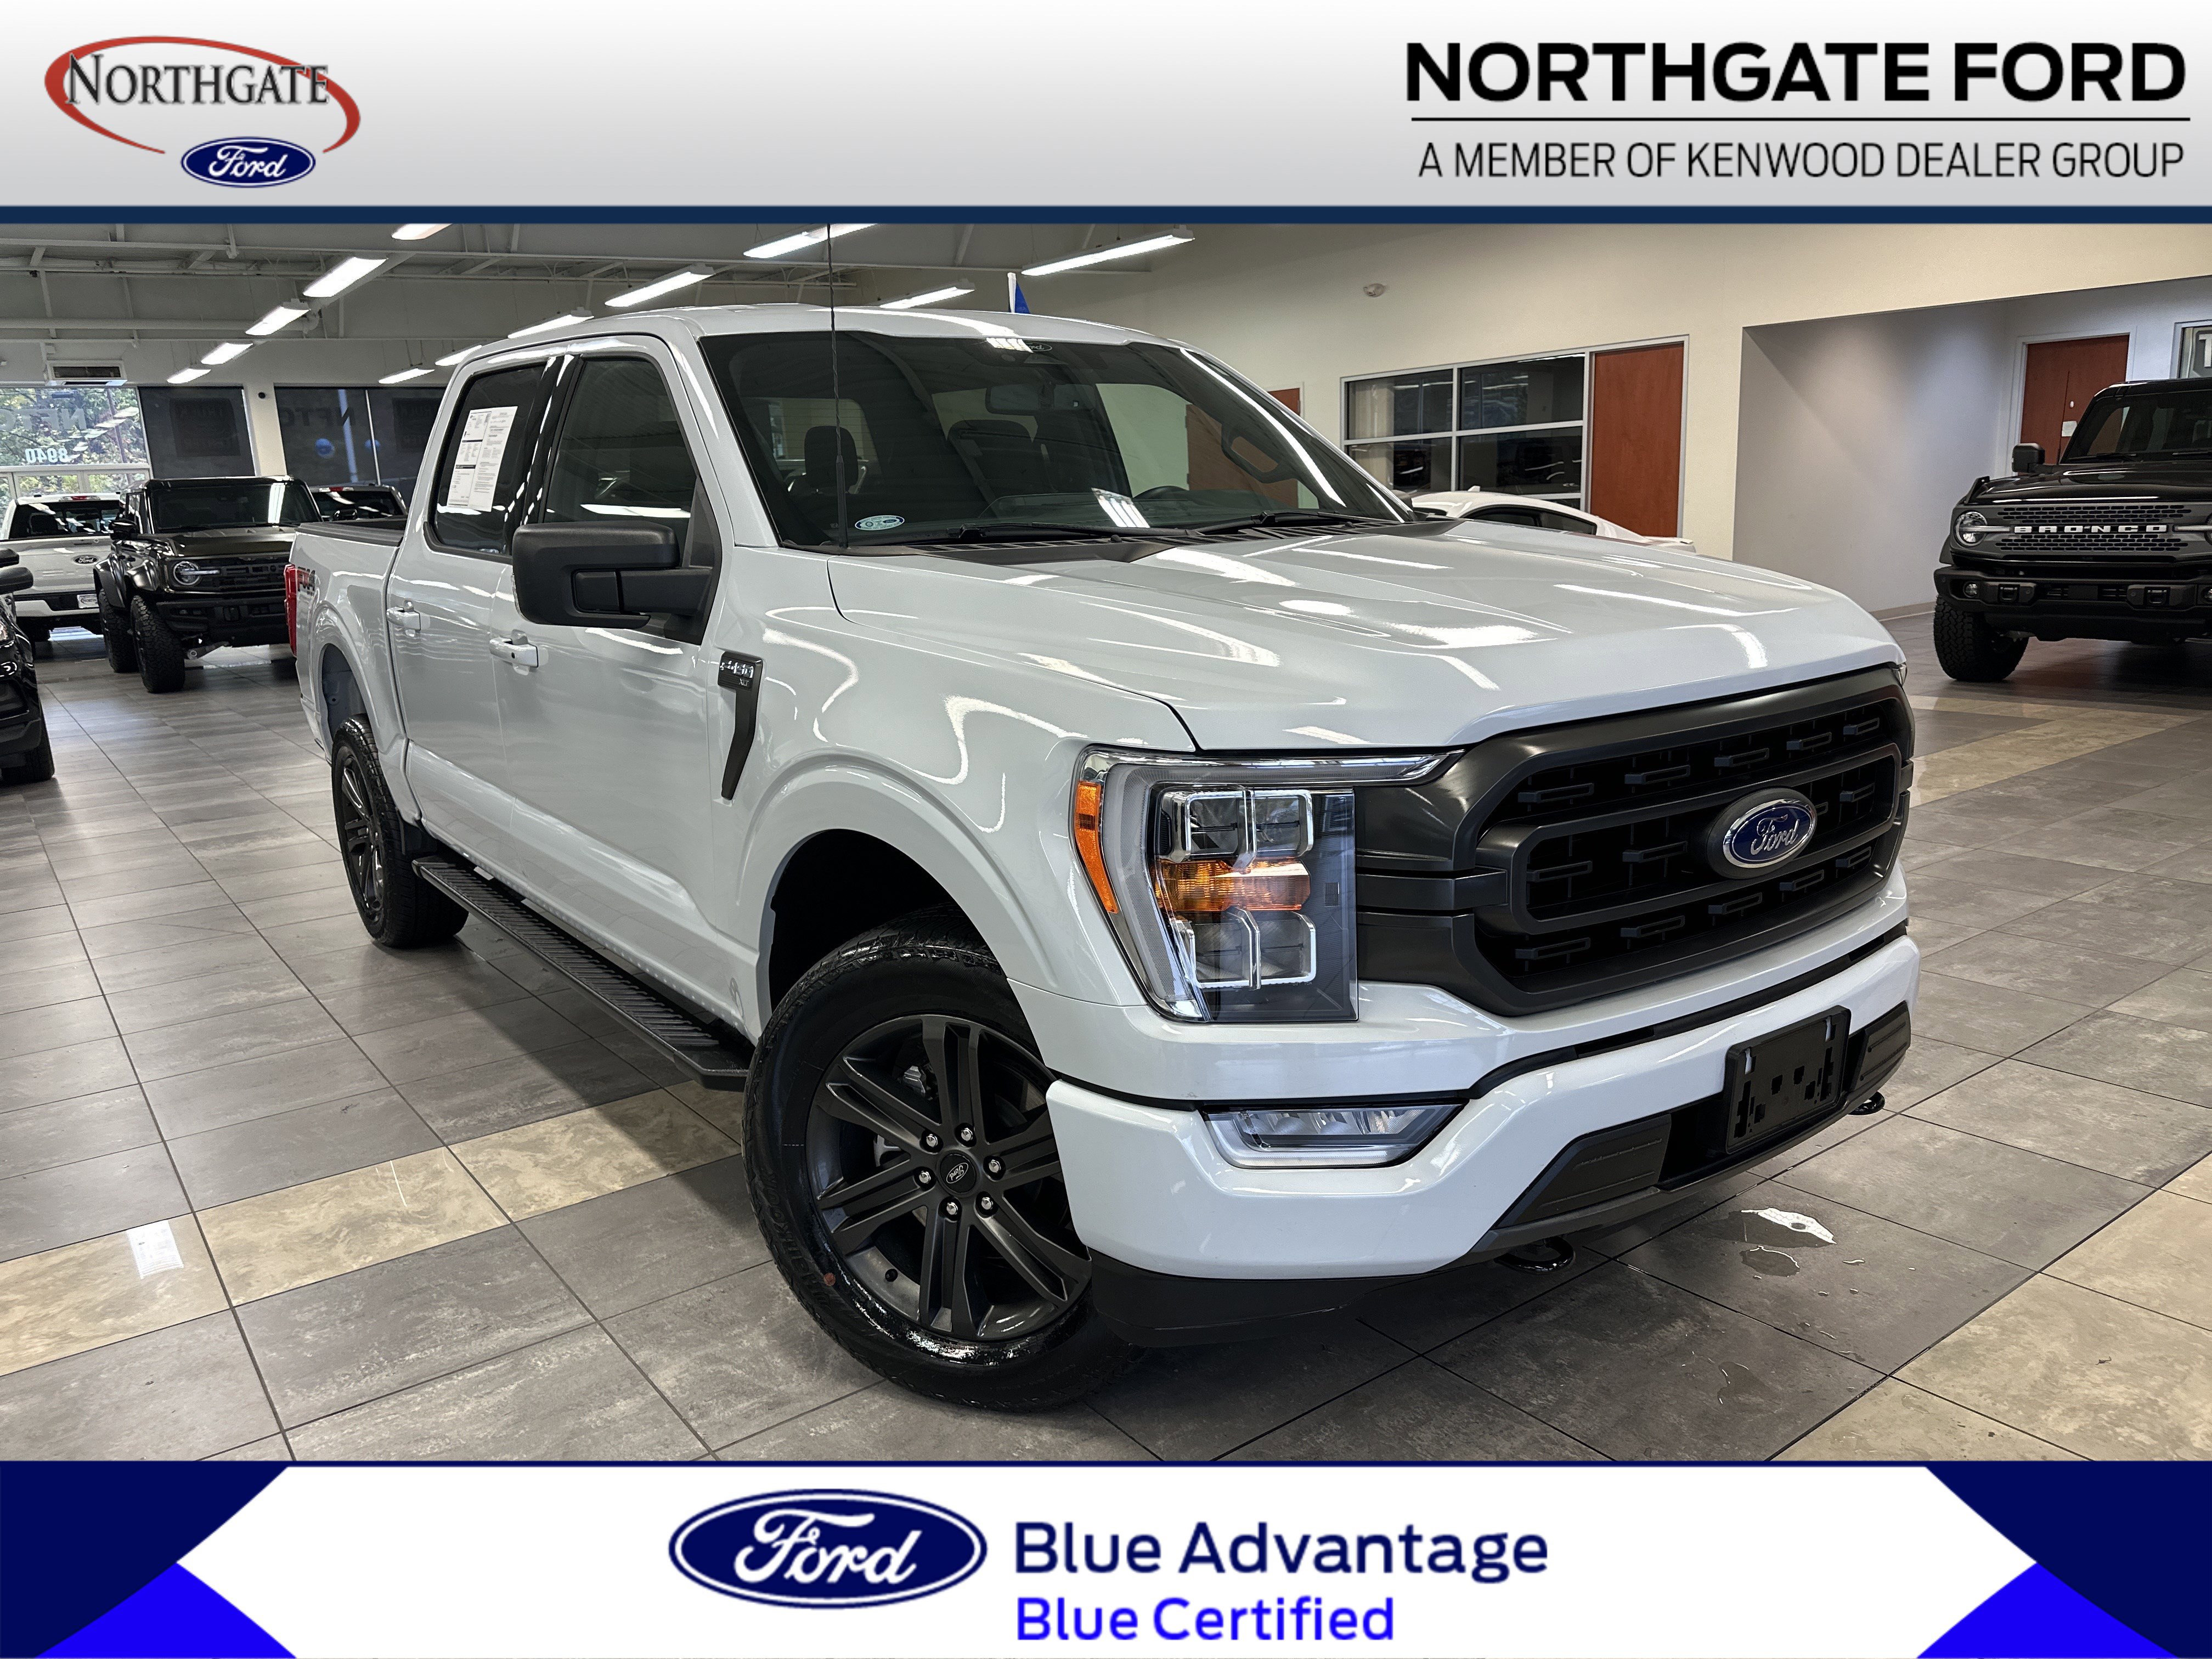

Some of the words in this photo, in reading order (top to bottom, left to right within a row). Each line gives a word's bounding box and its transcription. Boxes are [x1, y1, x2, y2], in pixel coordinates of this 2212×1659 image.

[2014, 524, 2167, 533] BRONCO
[738, 678, 749, 687] XLT
[1750, 814, 1801, 855] Ford
[949, 1164, 964, 1181] Ford
